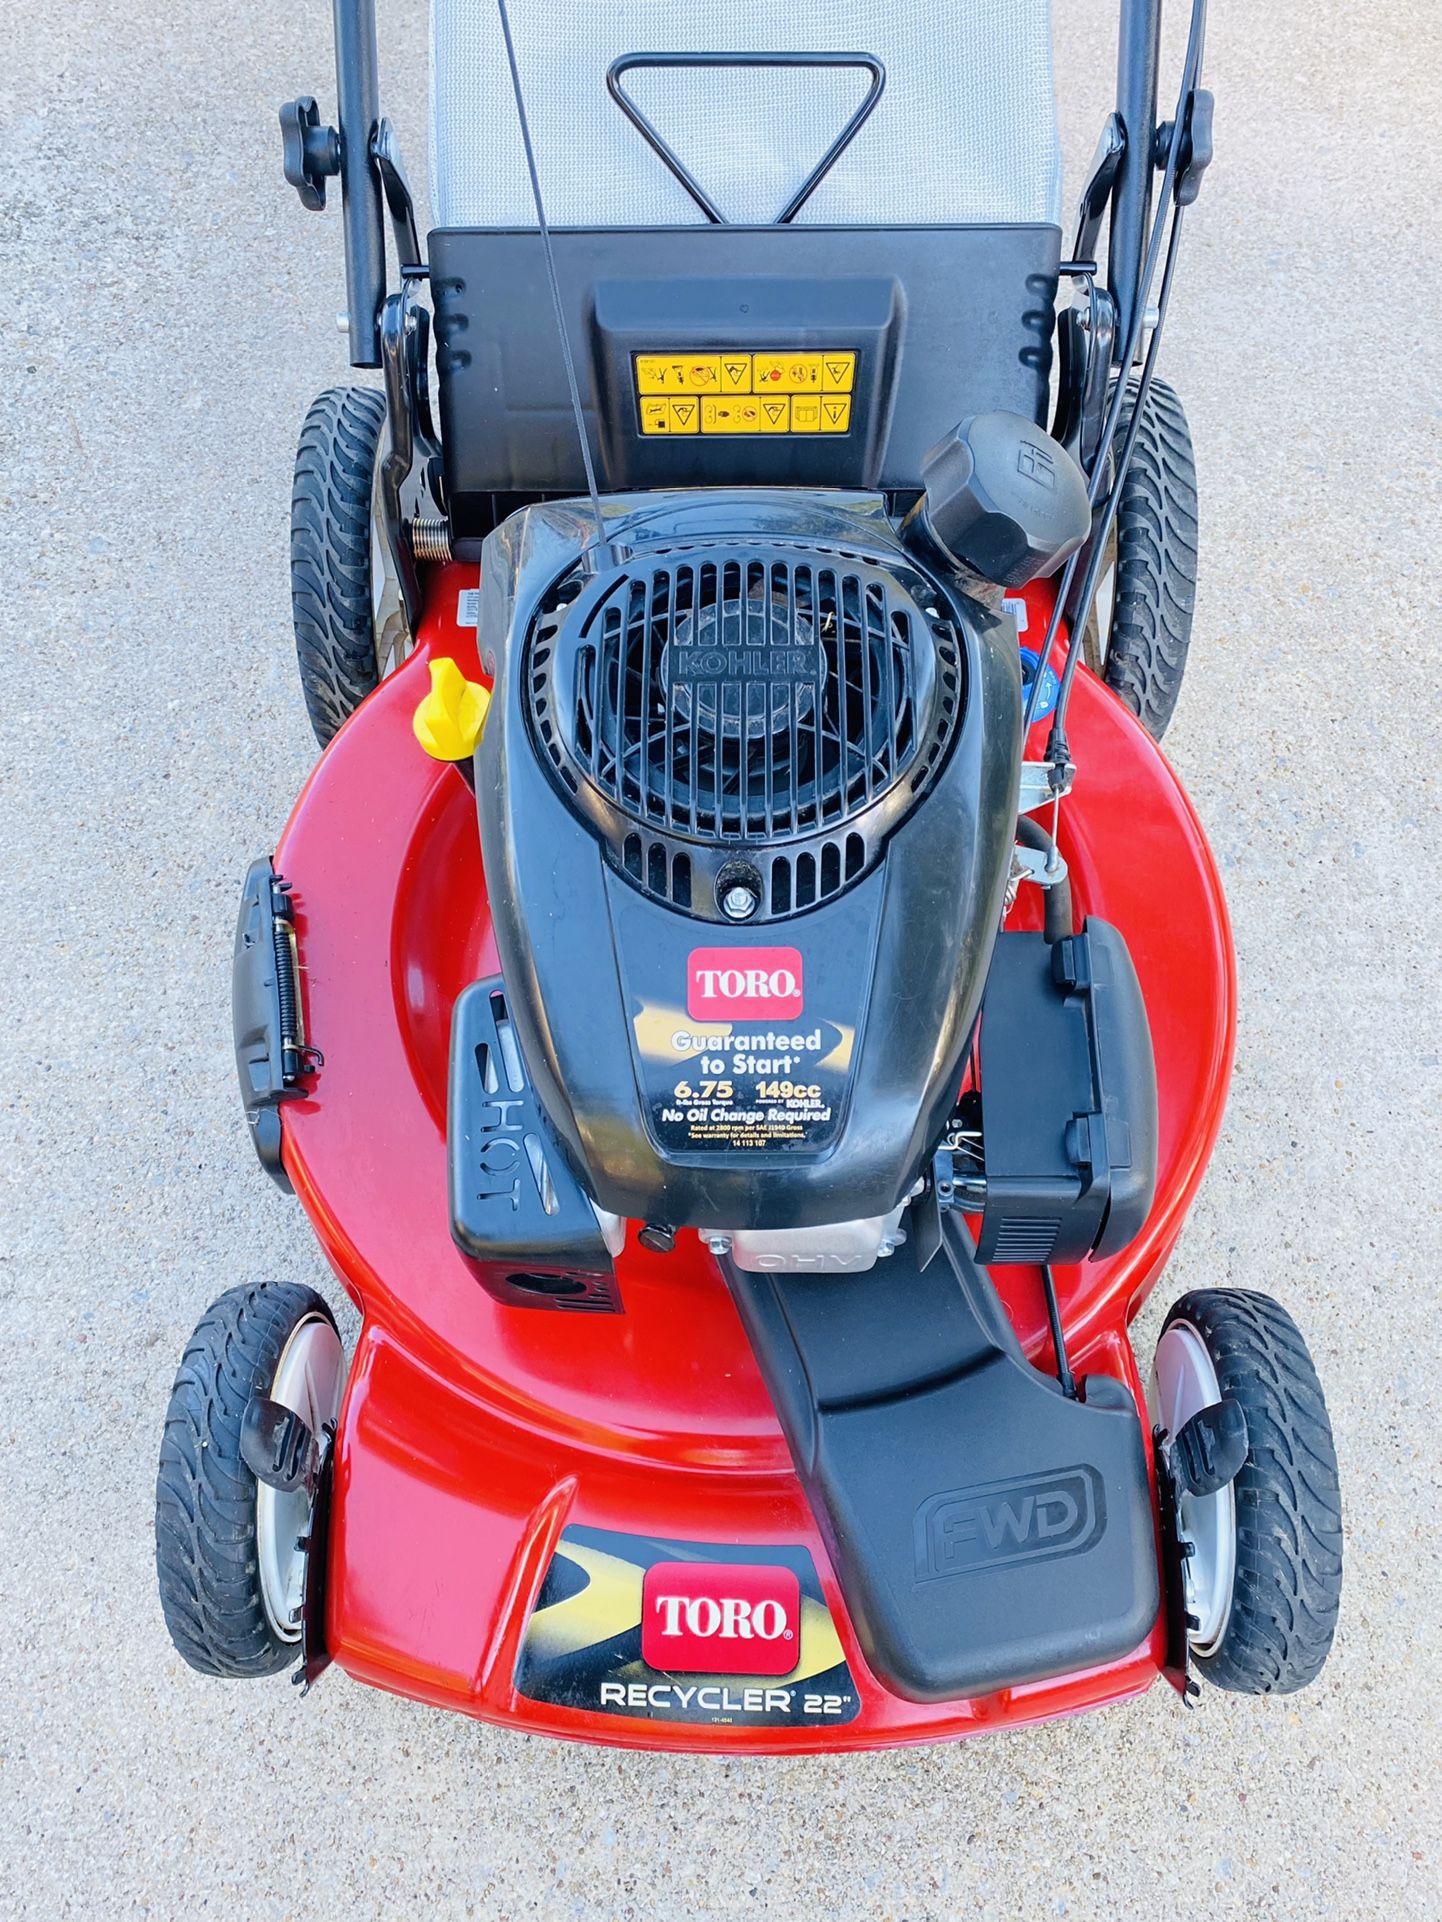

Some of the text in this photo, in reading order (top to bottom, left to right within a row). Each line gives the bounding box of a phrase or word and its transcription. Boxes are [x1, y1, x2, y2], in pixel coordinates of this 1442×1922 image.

[679, 650, 811, 675] KOHLER
[671, 1029, 822, 1051] Guaranteed
[701, 1055, 726, 1075] to
[674, 1081, 822, 1098] 6.75 149cc
[662, 1107, 832, 1124] No Oil Change Required
[732, 1139, 741, 1147] 14
[476, 1100, 525, 1212] HOT
[943, 1490, 1078, 1560] FWD
[803, 1694, 852, 1715] 22"
